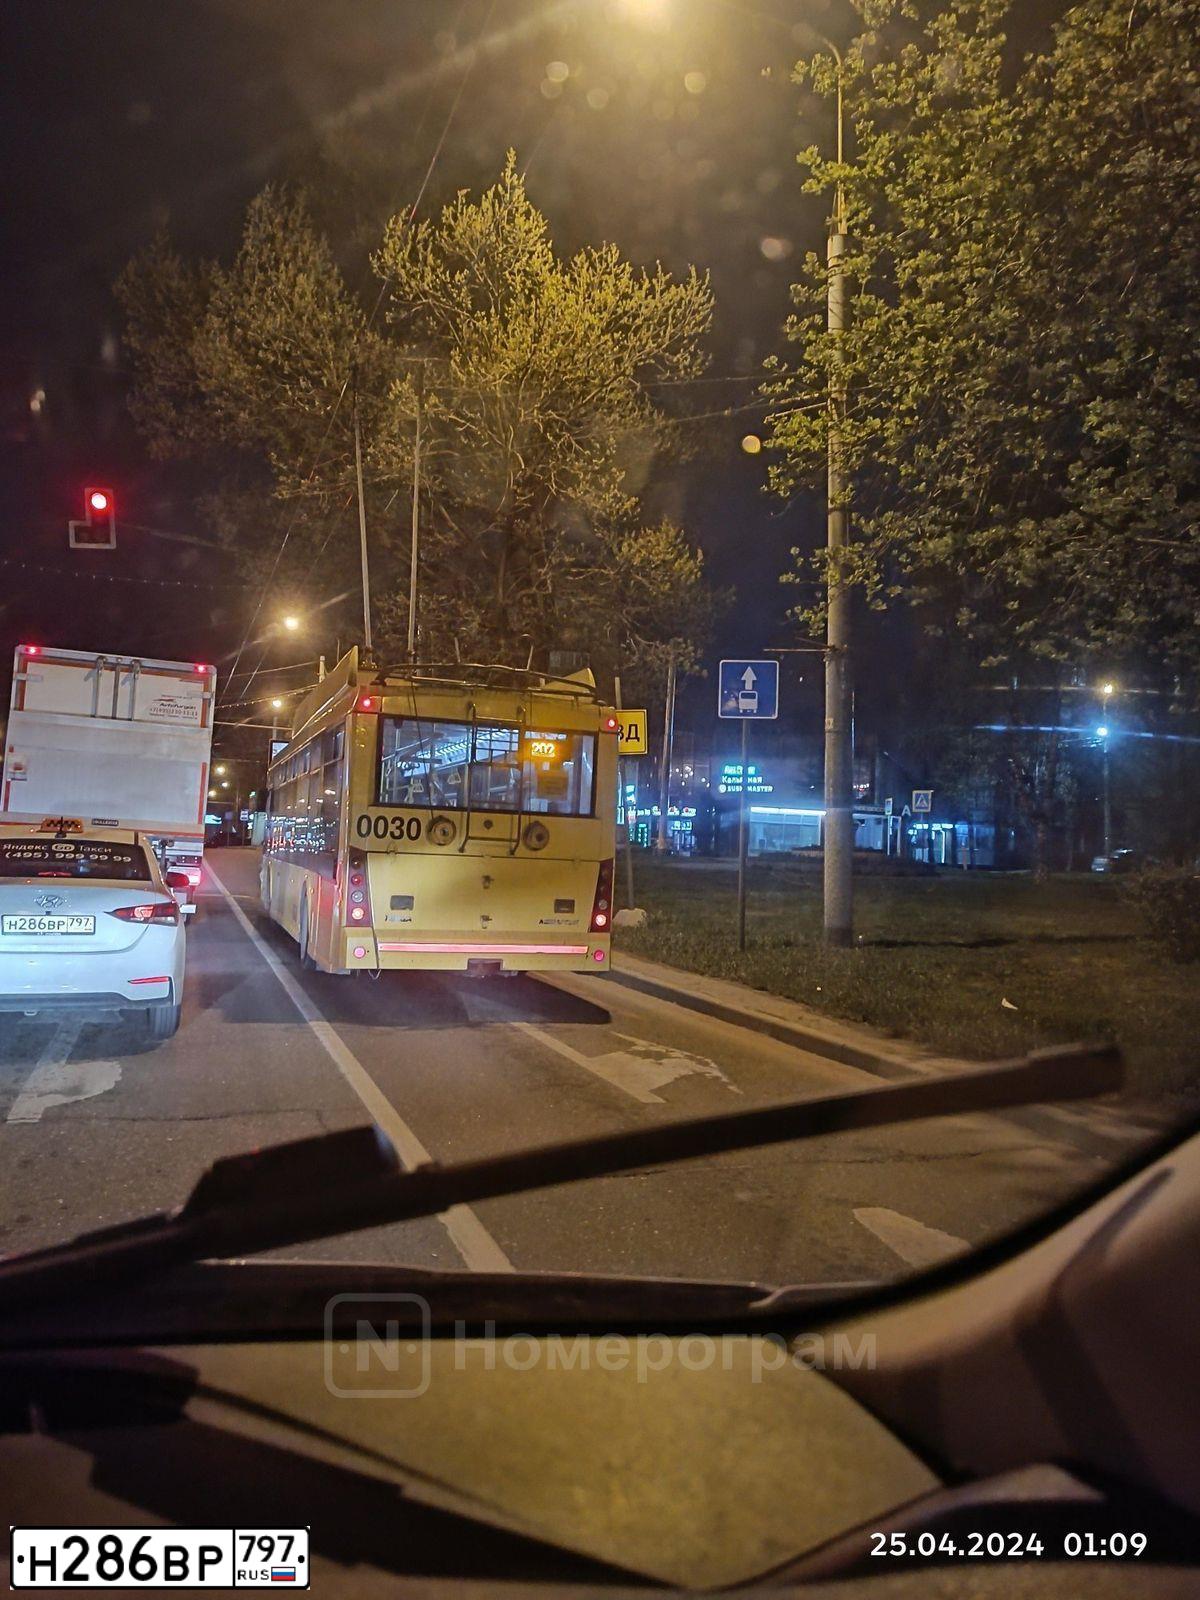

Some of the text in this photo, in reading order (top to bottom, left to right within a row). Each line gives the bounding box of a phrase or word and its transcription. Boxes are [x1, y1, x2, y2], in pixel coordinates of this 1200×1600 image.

[356, 814, 422, 841] 0030
[2, 843, 48, 851] Яндекс
[79, 845, 112, 853] Такси
[5, 851, 49, 859] (495)
[69, 917, 90, 927] 797
